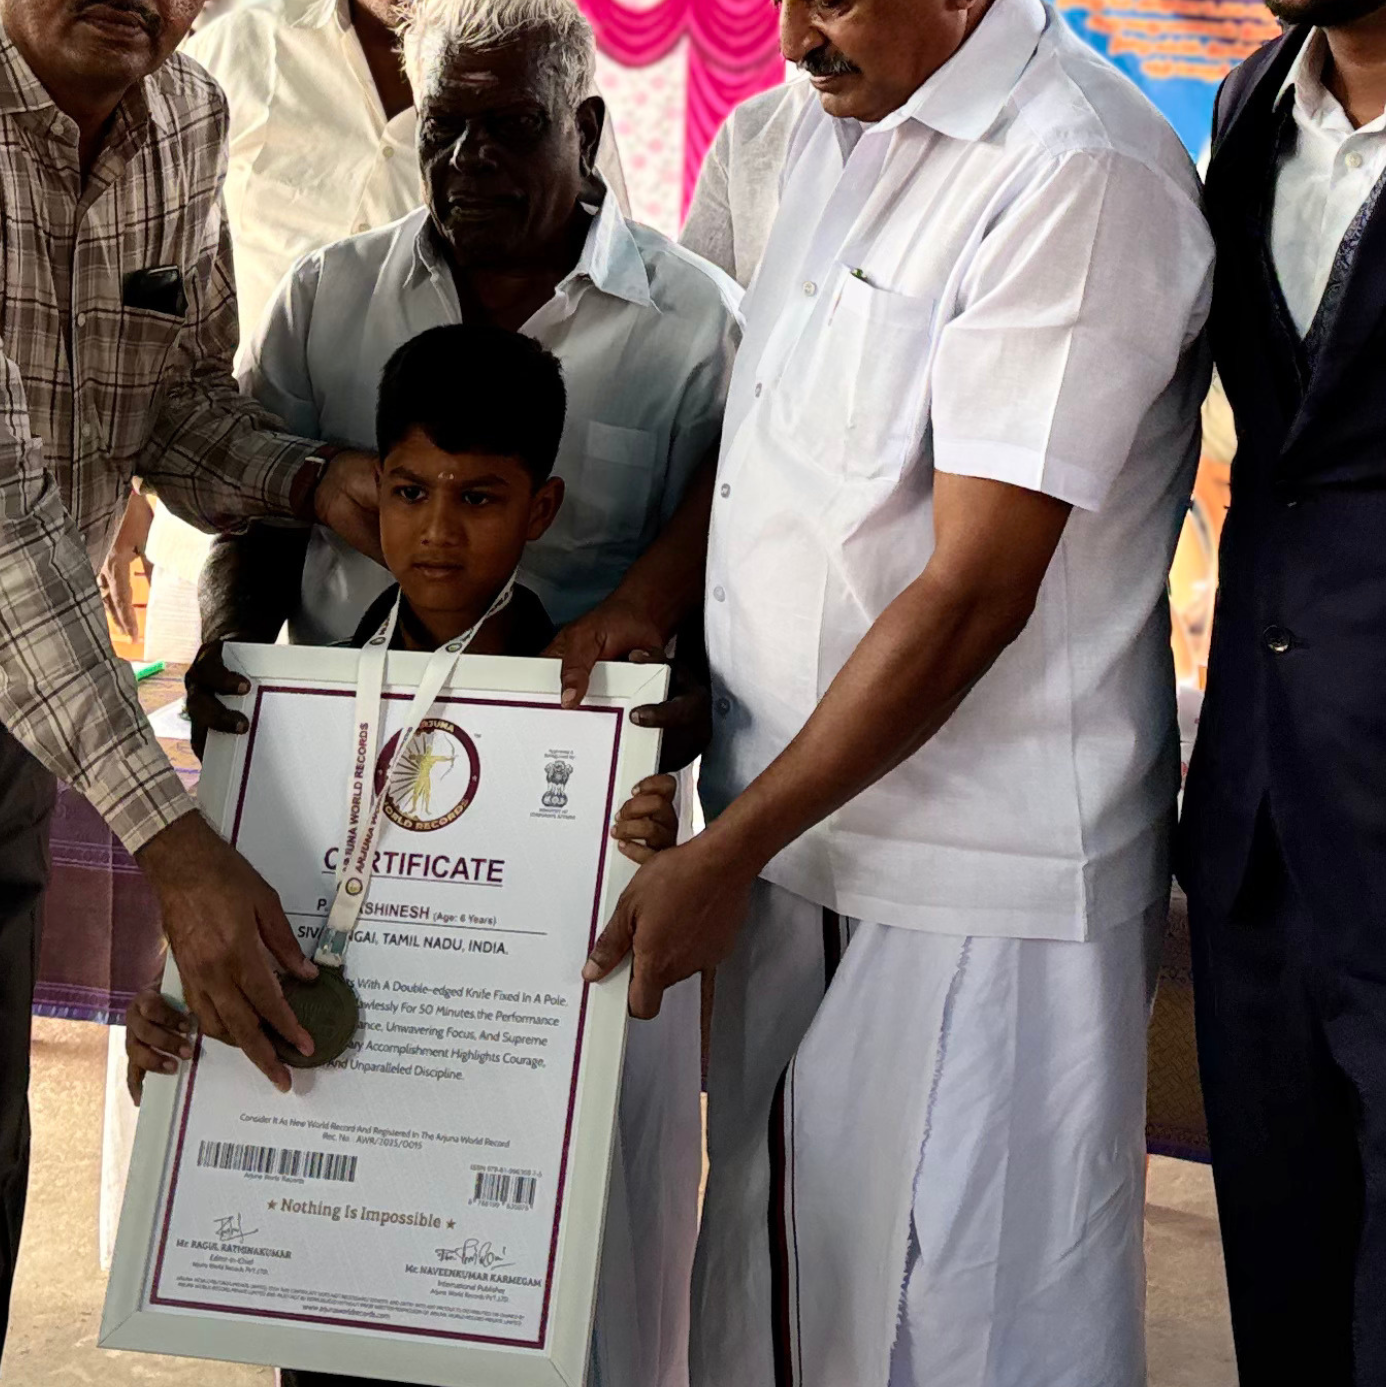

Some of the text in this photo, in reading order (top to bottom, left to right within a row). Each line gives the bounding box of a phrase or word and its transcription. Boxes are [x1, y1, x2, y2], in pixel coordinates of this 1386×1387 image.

[419, 718, 455, 733] RJUNA
[354, 722, 370, 779] RECORDS
[348, 782, 364, 829] WORLD
[382, 798, 470, 831] ORLD RECORDS
[356, 826, 375, 874] ARJUNA
[323, 846, 505, 883] CRTIFICATE
[468, 914, 497, 926] Years)
[383, 932, 421, 948] TAMIL
[423, 937, 465, 952] NADU,
[468, 941, 509, 956] INDIA.
[357, 978, 381, 991] With
[382, 980, 391, 991] A
[392, 981, 464, 1000] Double-edged
[465, 987, 492, 1000] Knife
[493, 989, 520, 1003] Fixed
[522, 992, 532, 1004] In
[533, 993, 542, 1005] A
[400, 1002, 417, 1014] For
[419, 1004, 434, 1016] 50
[495, 1010, 560, 1027] Performance
[386, 1021, 444, 1040] Unwavering
[479, 1030, 500, 1042] And
[502, 1032, 549, 1047] Supreme
[365, 1042, 449, 1060] Accomplishment
[451, 1048, 501, 1064] Highlights
[350, 1060, 413, 1076] Unparalleled
[239, 1113, 271, 1125] Consider
[289, 1118, 307, 1128] New
[308, 1120, 330, 1130] World
[356, 1125, 372, 1135] And
[421, 1131, 435, 1141] The
[460, 1135, 483, 1146] World
[484, 1138, 511, 1149] Record
[280, 1198, 342, 1222] Nothing
[361, 1206, 441, 1229] Impossible
